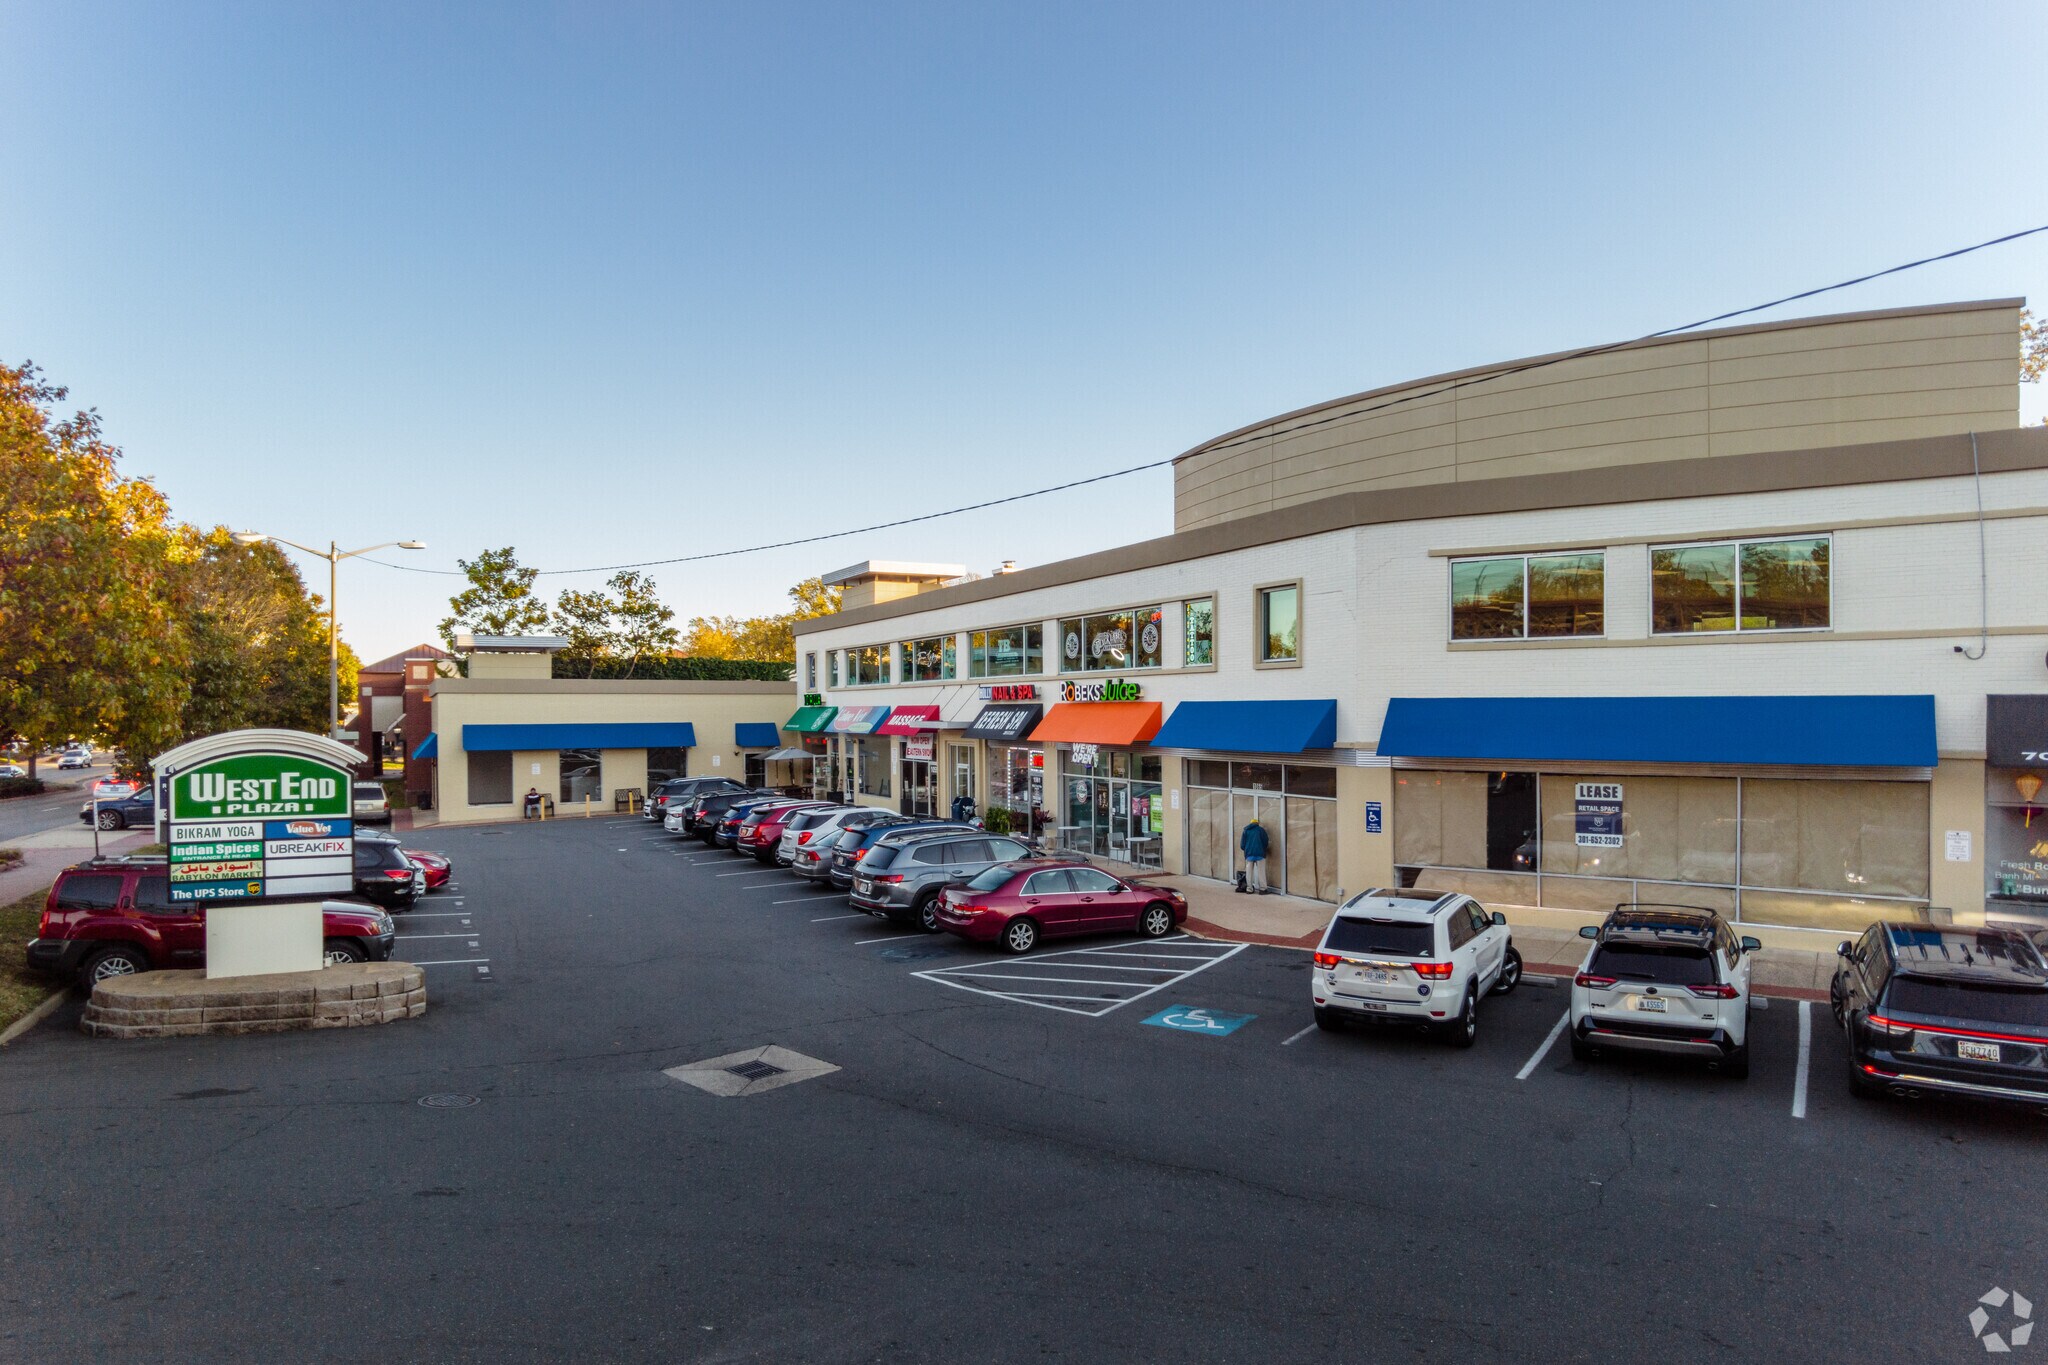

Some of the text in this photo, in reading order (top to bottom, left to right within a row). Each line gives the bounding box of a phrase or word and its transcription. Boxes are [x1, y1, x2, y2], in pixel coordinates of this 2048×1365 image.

[992, 686, 1010, 700] NAIL
[1010, 685, 1016, 700] &
[1017, 684, 1034, 700] SPA
[1060, 678, 1137, 701] ROBEKS Juice
[973, 711, 1029, 730] REFRESH SPA
[1072, 743, 1098, 755] WE'RE
[1071, 753, 1093, 764] OPEN
[1580, 785, 1618, 798] LEASE
[227, 802, 300, 815] PLAZA
[176, 826, 255, 840] BIKRAM YOGA
[285, 822, 332, 834] Value Vet
[1578, 836, 1620, 845] 301-652-2302
[172, 843, 260, 856] Indian Spices
[269, 842, 345, 854] UBREAKIFIX
[2000, 859, 2031, 870] Fresh
[172, 871, 262, 881] BABYLON MARKET
[1995, 871, 2020, 880] Banh
[172, 890, 192, 899] The
[194, 888, 216, 898] UPS
[217, 887, 244, 897] Store
